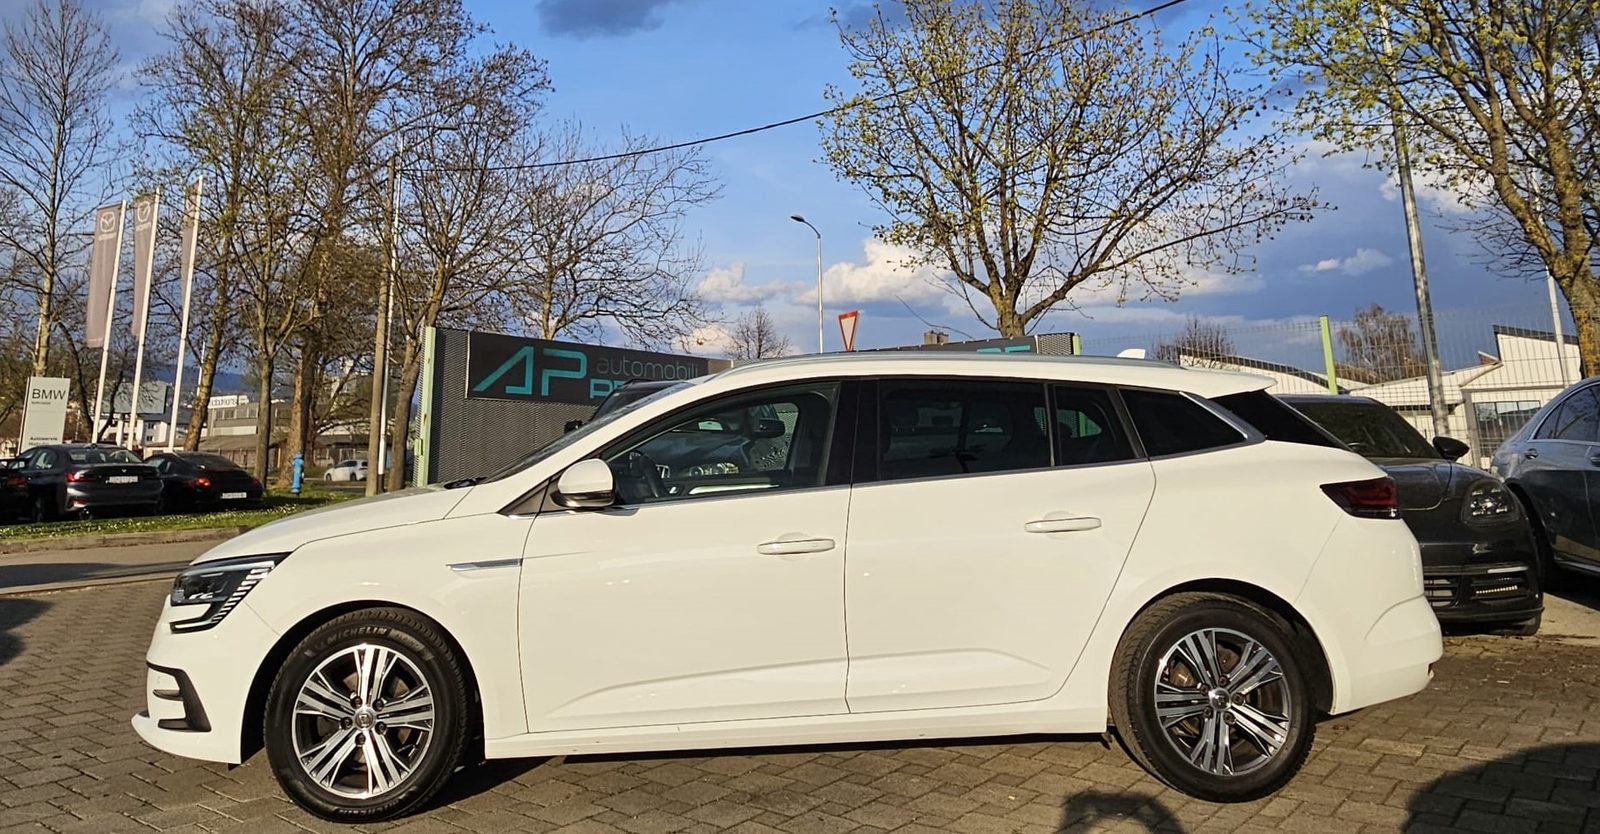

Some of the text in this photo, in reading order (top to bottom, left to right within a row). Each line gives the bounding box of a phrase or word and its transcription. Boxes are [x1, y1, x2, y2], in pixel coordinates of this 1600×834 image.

[472, 346, 699, 396] AP automobili
[31, 388, 67, 400] BMW
[327, 625, 389, 646] MICHELIN
